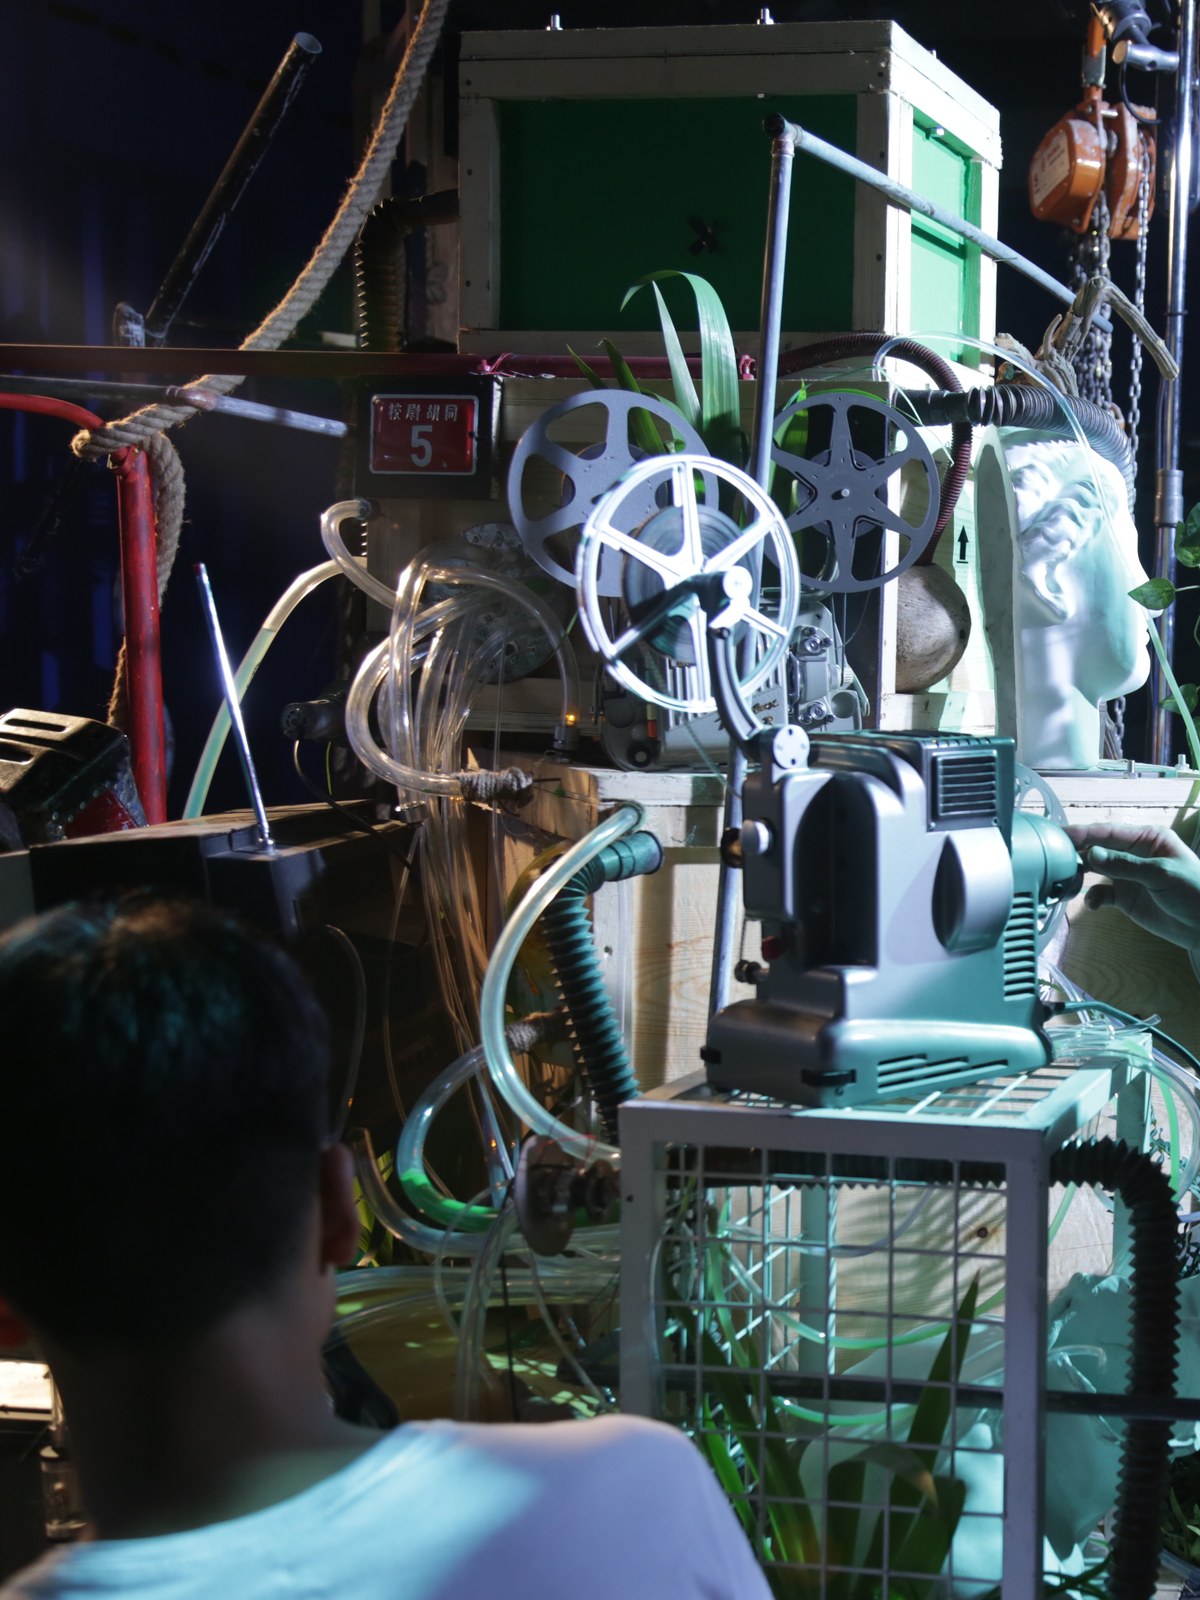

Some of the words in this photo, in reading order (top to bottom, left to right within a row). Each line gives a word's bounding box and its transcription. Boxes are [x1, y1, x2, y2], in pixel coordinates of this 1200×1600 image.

[389, 403, 458, 421] 校尉胡同
[411, 425, 433, 467] 5
